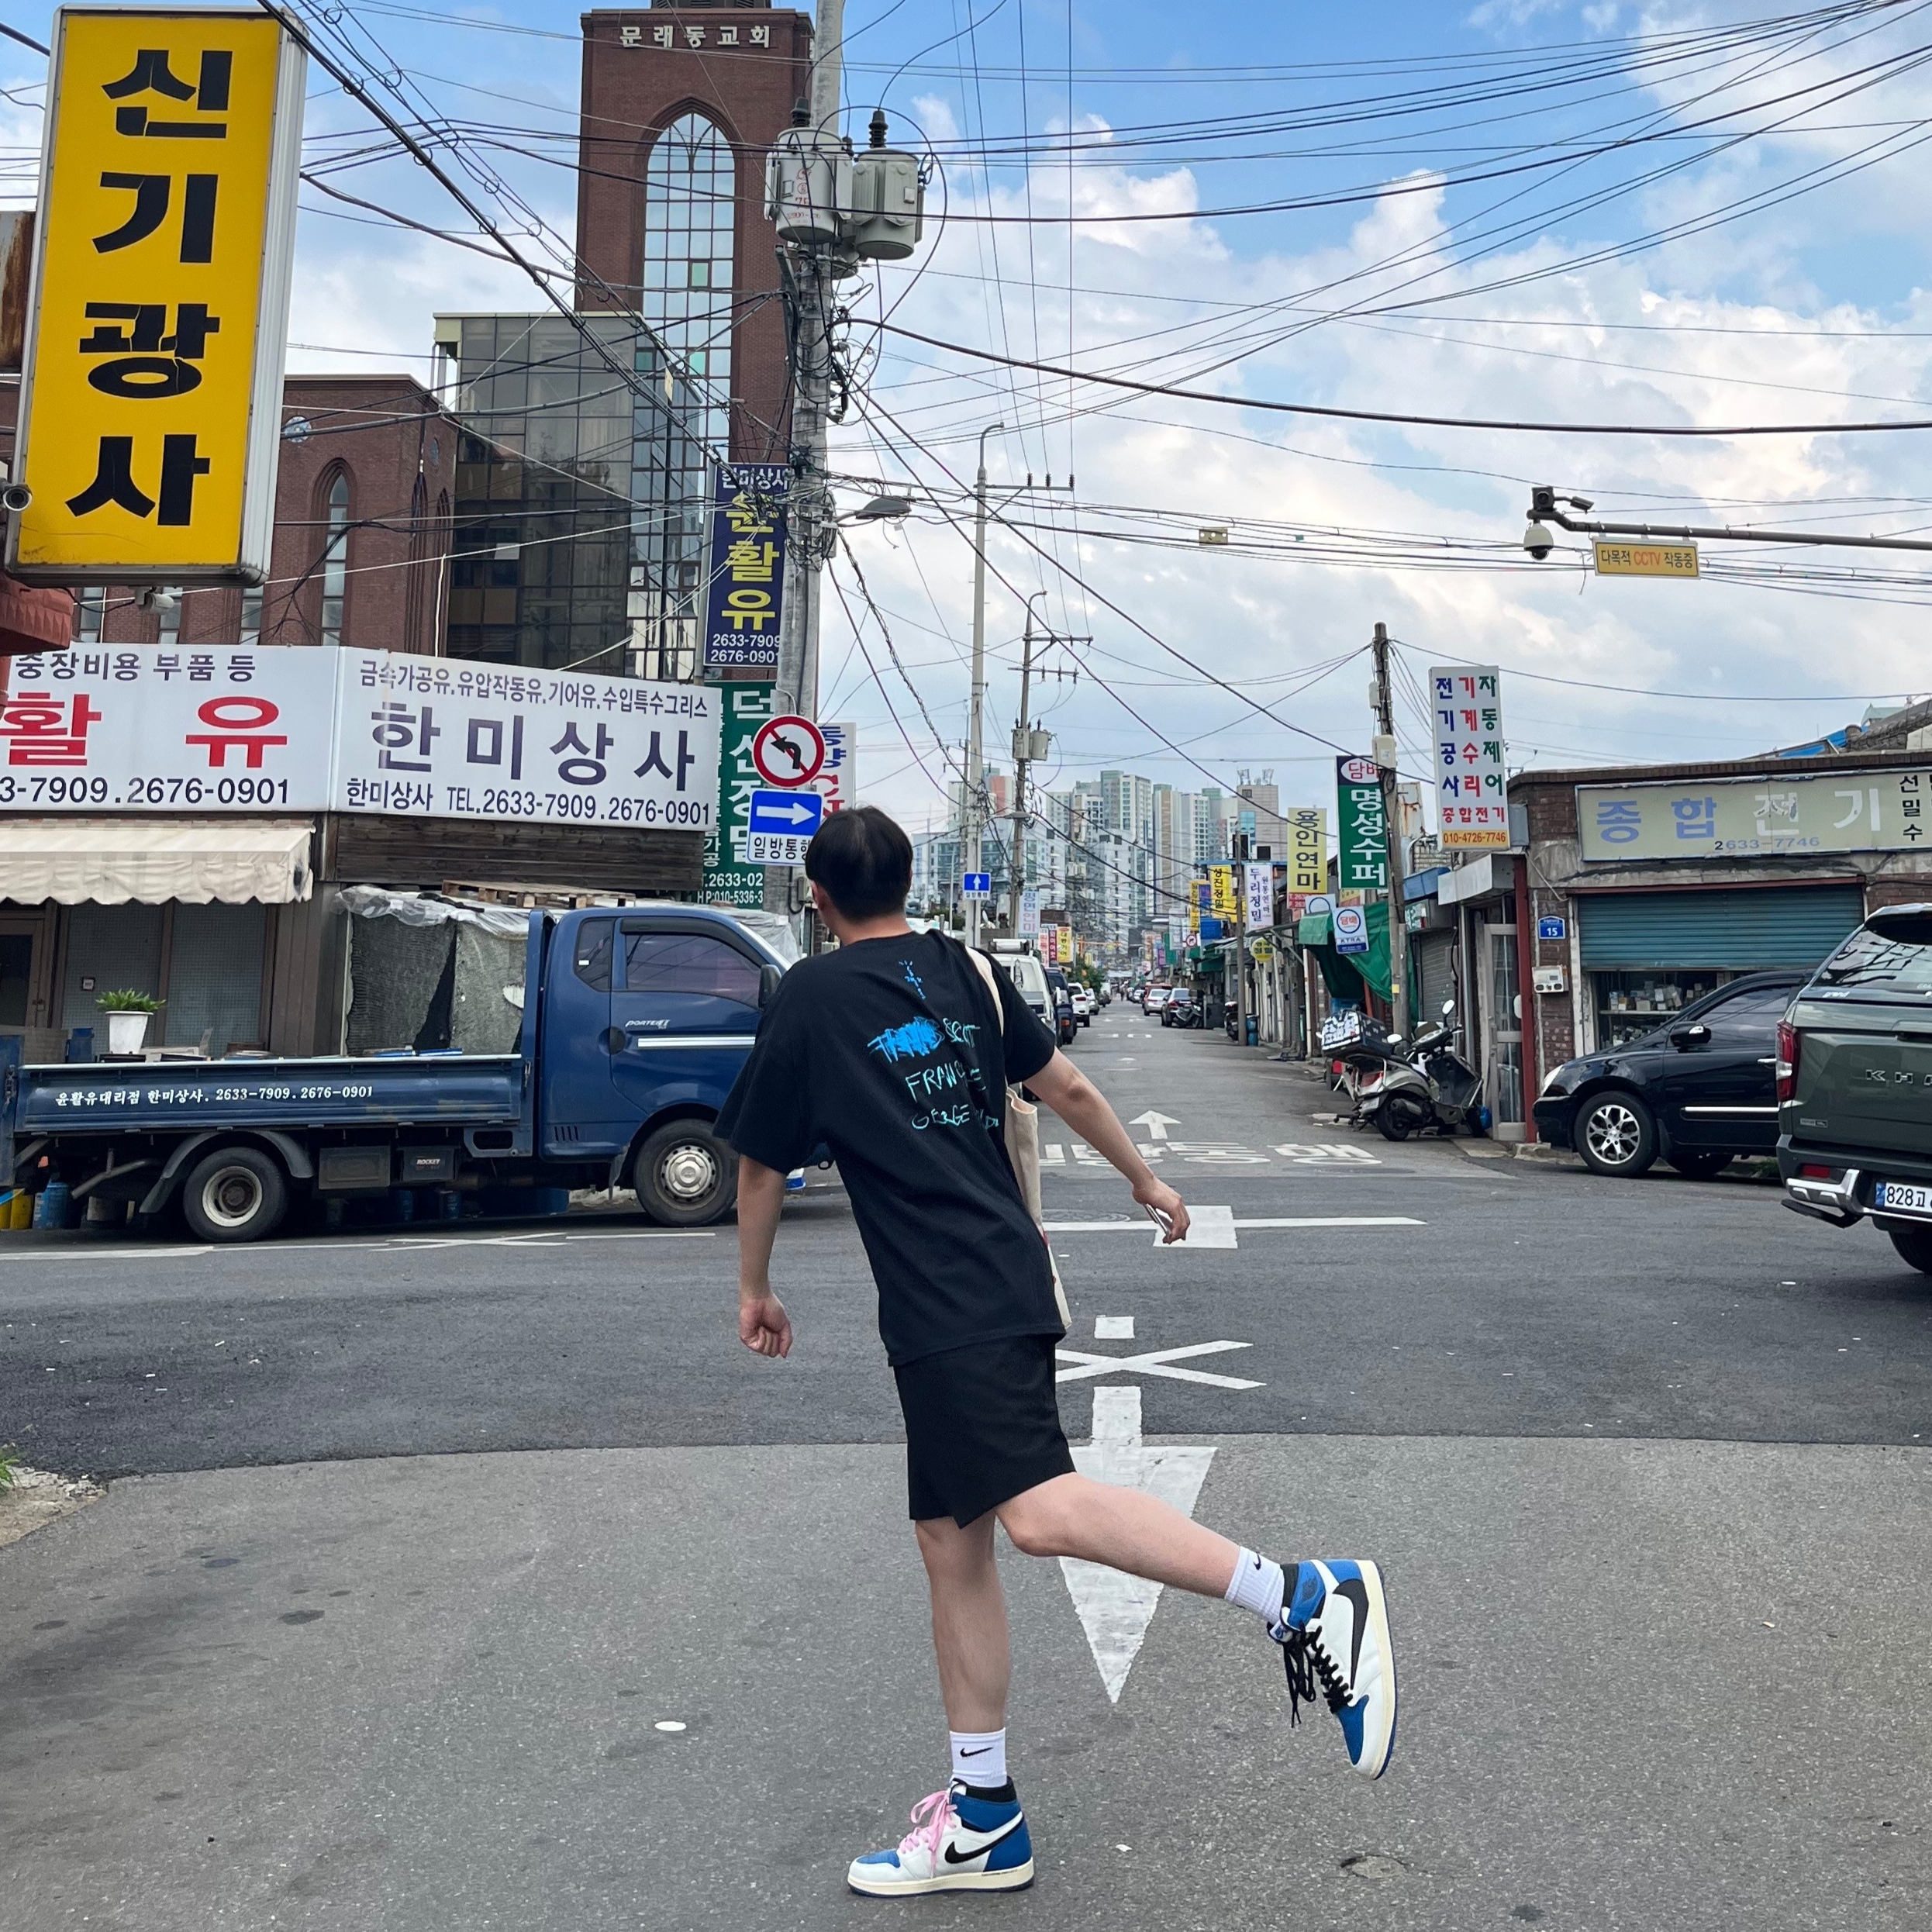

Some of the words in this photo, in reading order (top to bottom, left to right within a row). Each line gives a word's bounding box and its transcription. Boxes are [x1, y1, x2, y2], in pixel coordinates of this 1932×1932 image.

[619, 26, 771, 48] 문래동교회
[65, 49, 233, 526] 신기광사
[1601, 549, 1631, 567] 다목적
[1634, 550, 1661, 567] CCTV
[1664, 551, 1693, 569] 작동중
[227, 654, 256, 682] 등
[371, 701, 695, 792] 한미상사
[347, 777, 433, 812] 한미상사
[1442, 806, 1506, 823] 종합전기
[1596, 788, 1881, 844] 종합전기
[1295, 810, 1322, 891] 용인연마
[1350, 788, 1387, 886] 명성수퍼
[1443, 831, 1506, 844] 010-4726-7746
[1714, 836, 1820, 851] 2633-7746
[1250, 868, 1262, 922] 두리정밀
[1546, 927, 1558, 937] 15
[55, 1090, 140, 1106] 윤활유대리점
